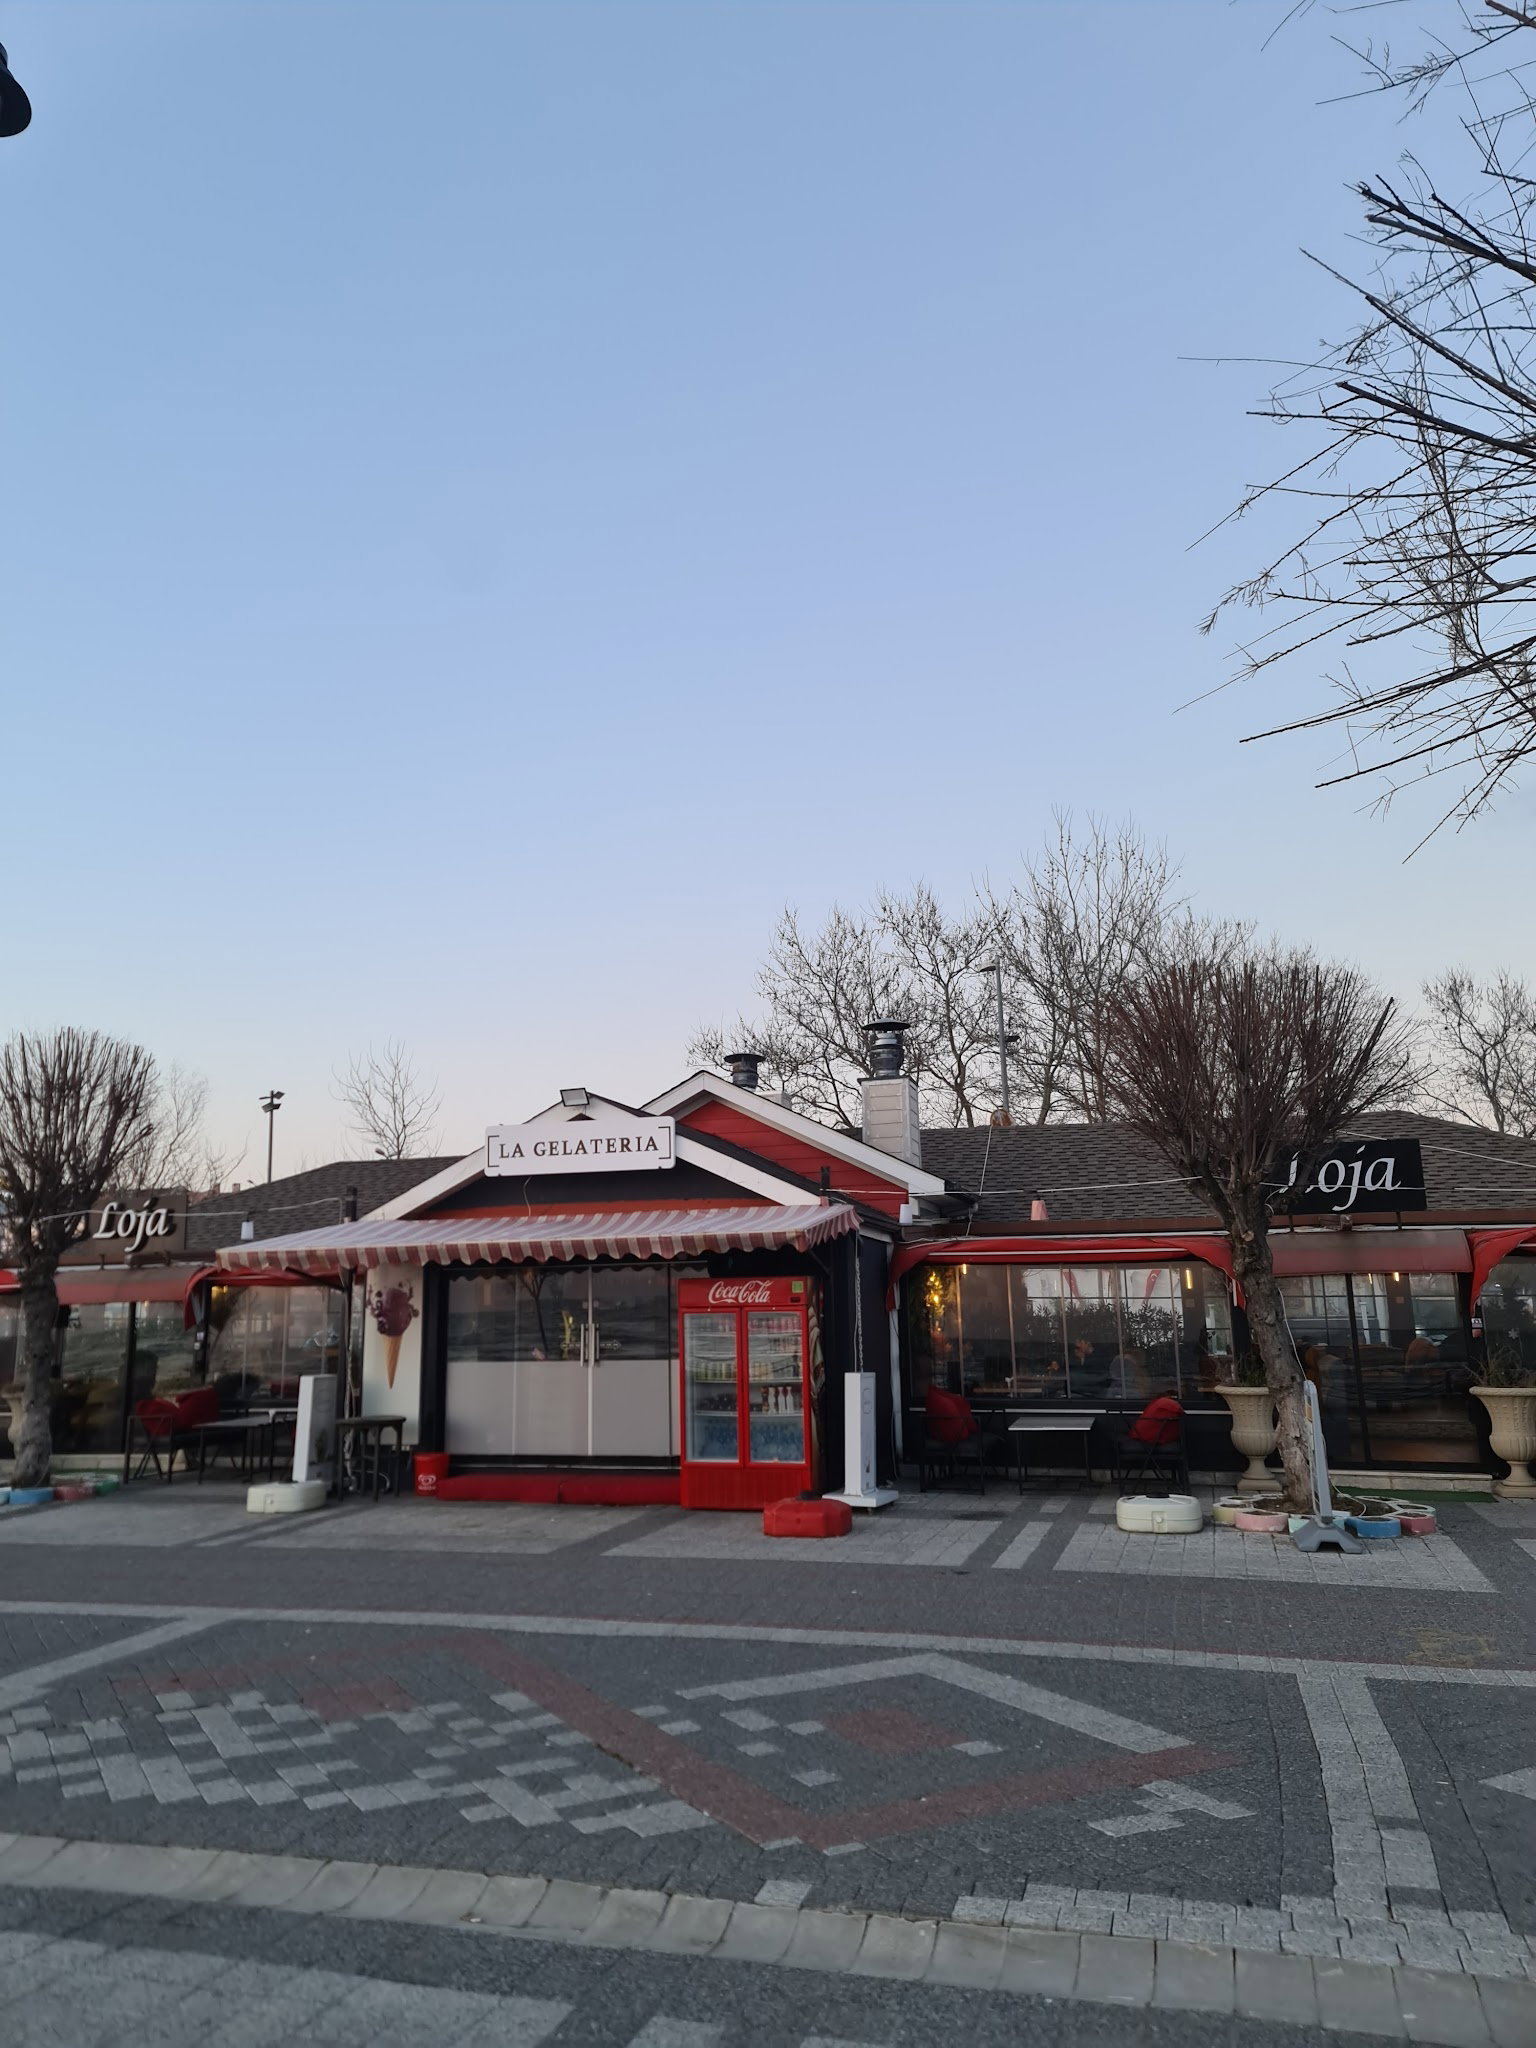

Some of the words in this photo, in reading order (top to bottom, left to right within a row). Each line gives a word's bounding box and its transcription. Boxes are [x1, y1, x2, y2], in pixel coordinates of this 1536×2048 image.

[499, 1143, 525, 1159] LA
[534, 1136, 658, 1157] GELATERIA
[92, 1199, 169, 1253] Loja
[708, 1280, 774, 1303] Coca-Cola
